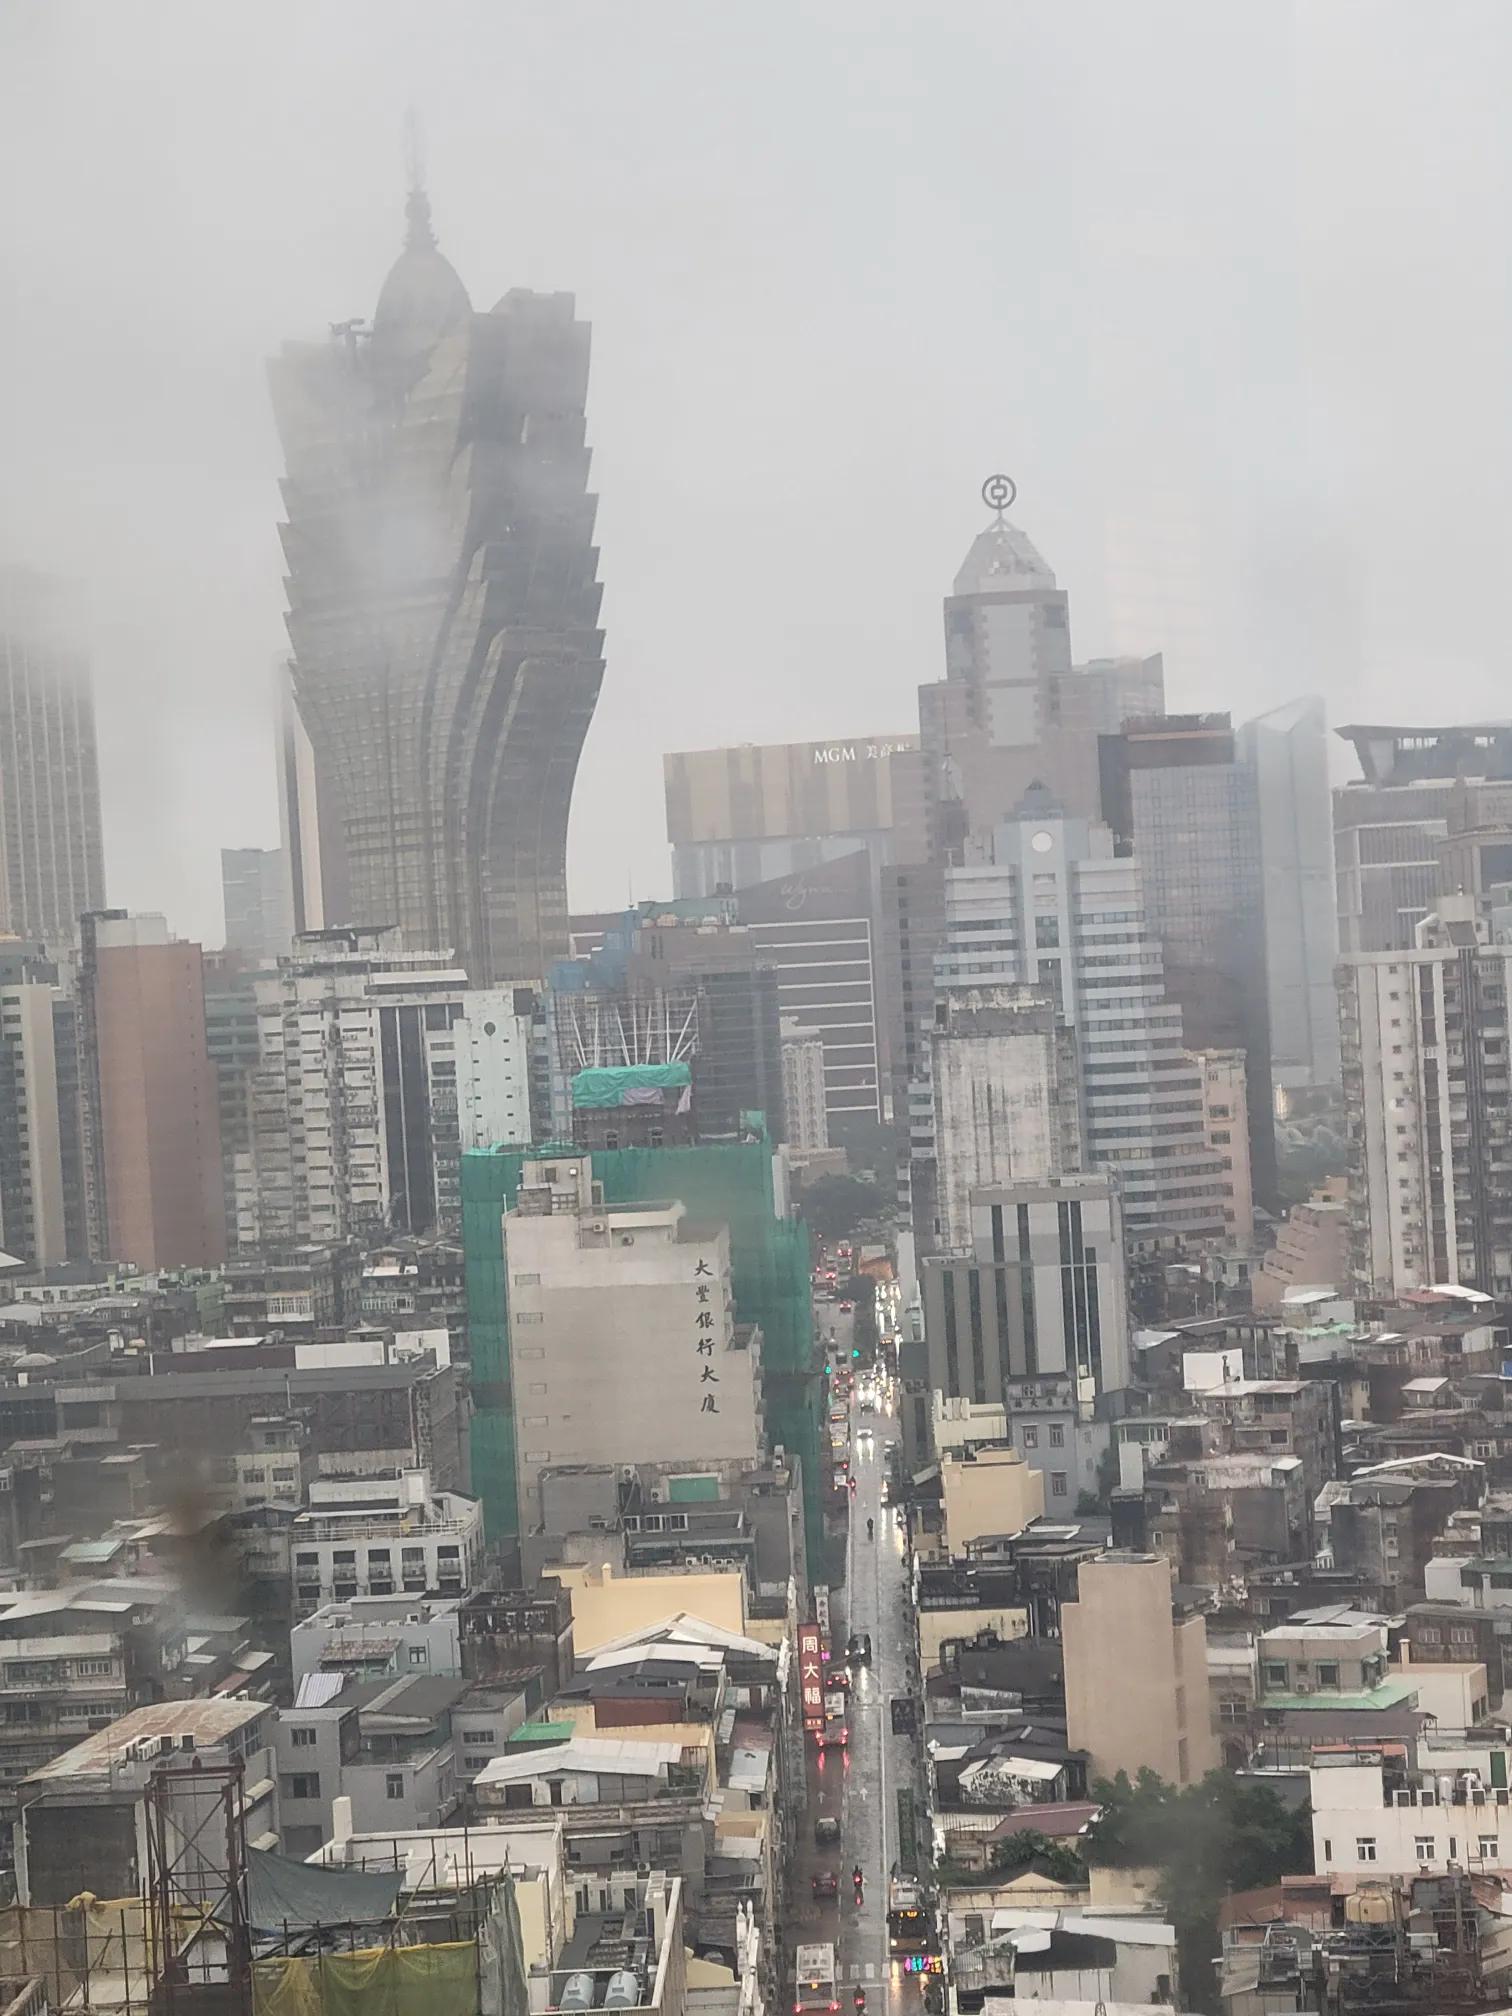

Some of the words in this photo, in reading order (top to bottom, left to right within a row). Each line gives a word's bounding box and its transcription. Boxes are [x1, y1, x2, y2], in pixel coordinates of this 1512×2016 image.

[814, 746, 856, 764] MGM
[802, 1635, 822, 1705] 周大福
